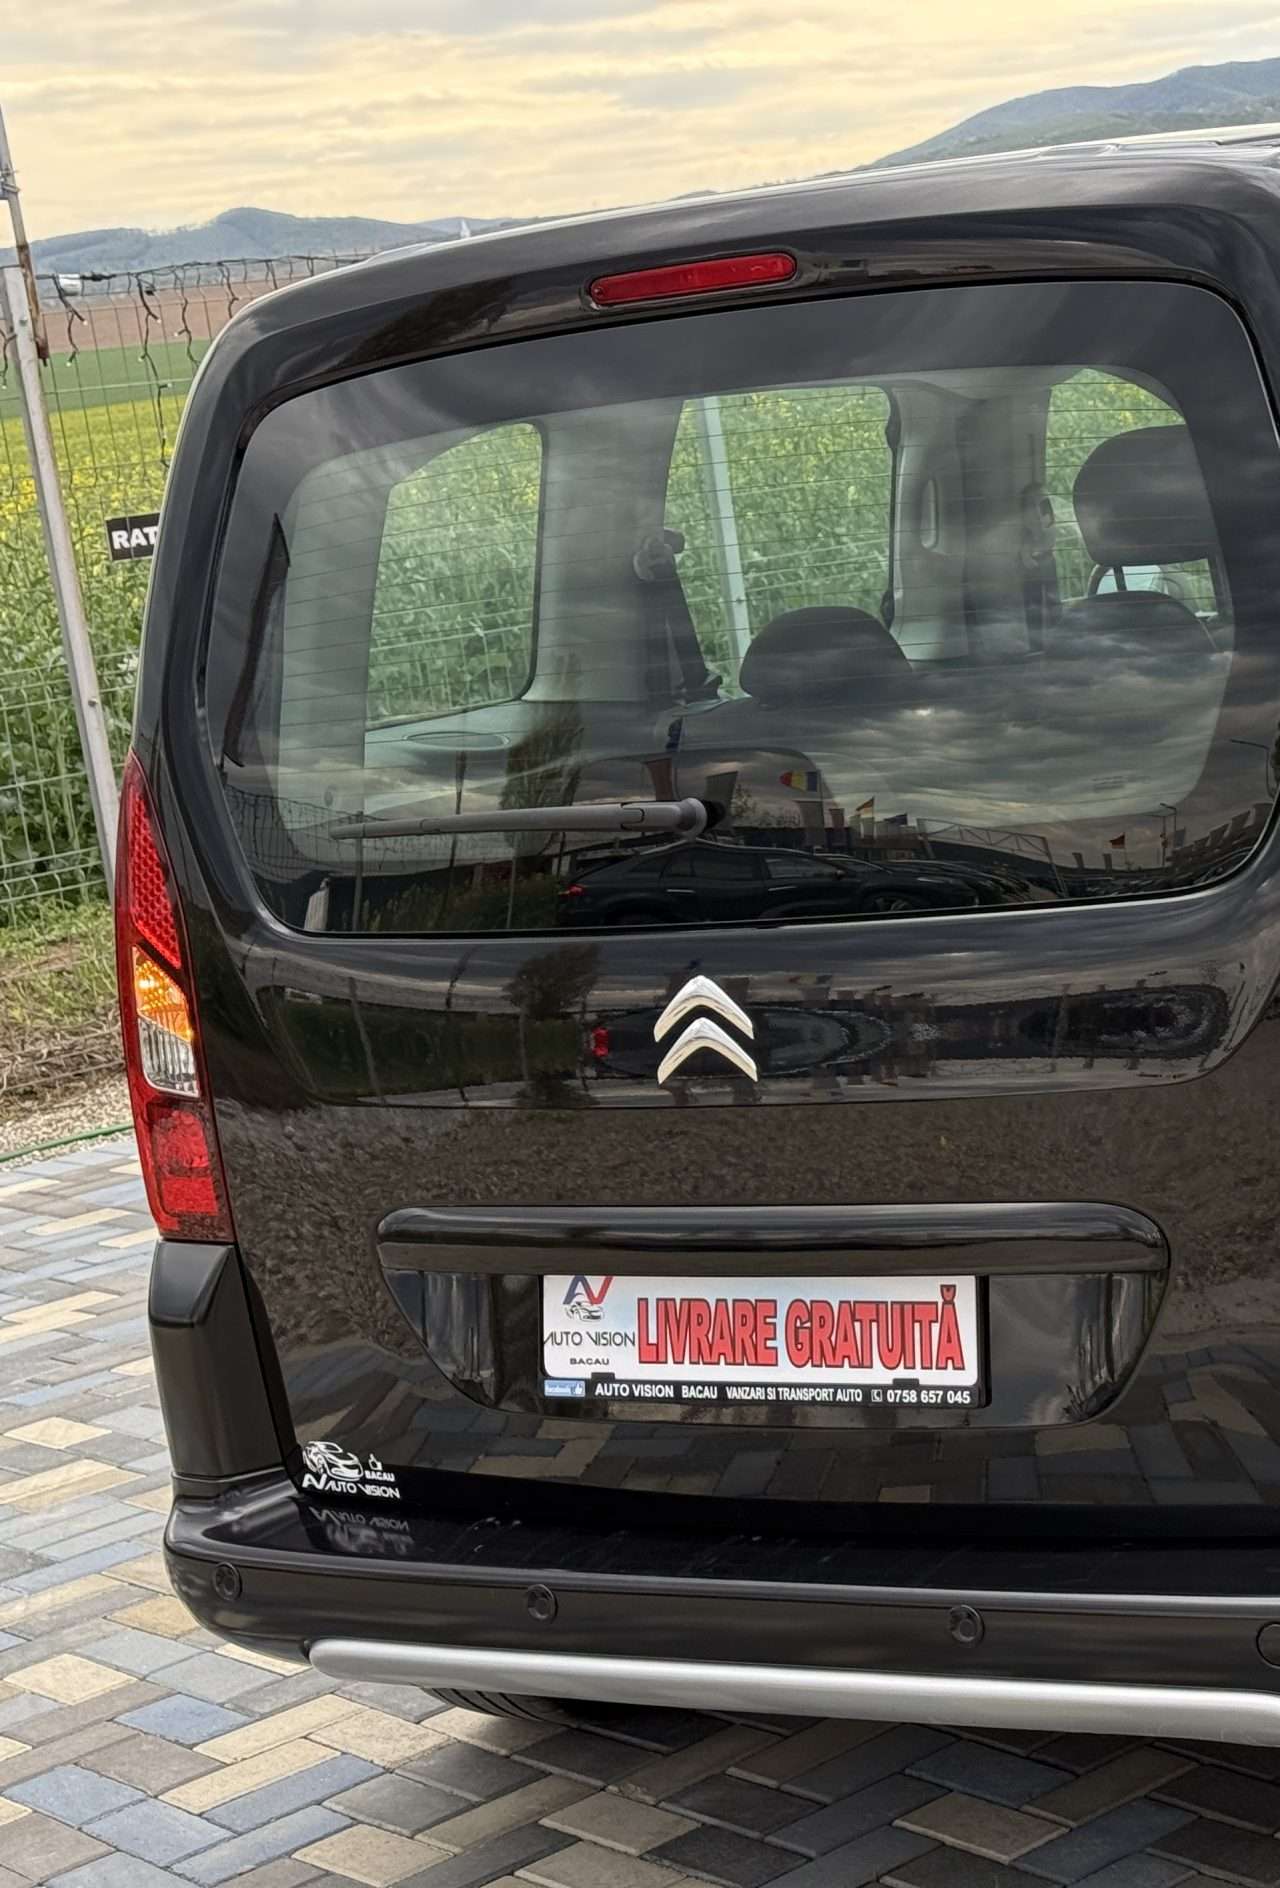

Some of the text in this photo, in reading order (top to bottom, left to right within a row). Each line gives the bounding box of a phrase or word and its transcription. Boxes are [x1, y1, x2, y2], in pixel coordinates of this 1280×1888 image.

[637, 1284, 966, 1371] LIVRARE GRATUITĂ
[543, 1331, 635, 1347] AUTO VISION
[569, 1357, 610, 1366] BACAU
[594, 1382, 971, 1405] AUTO VISION BACAU VANZARI SI TRANSPORT AUTO 0758 657 045
